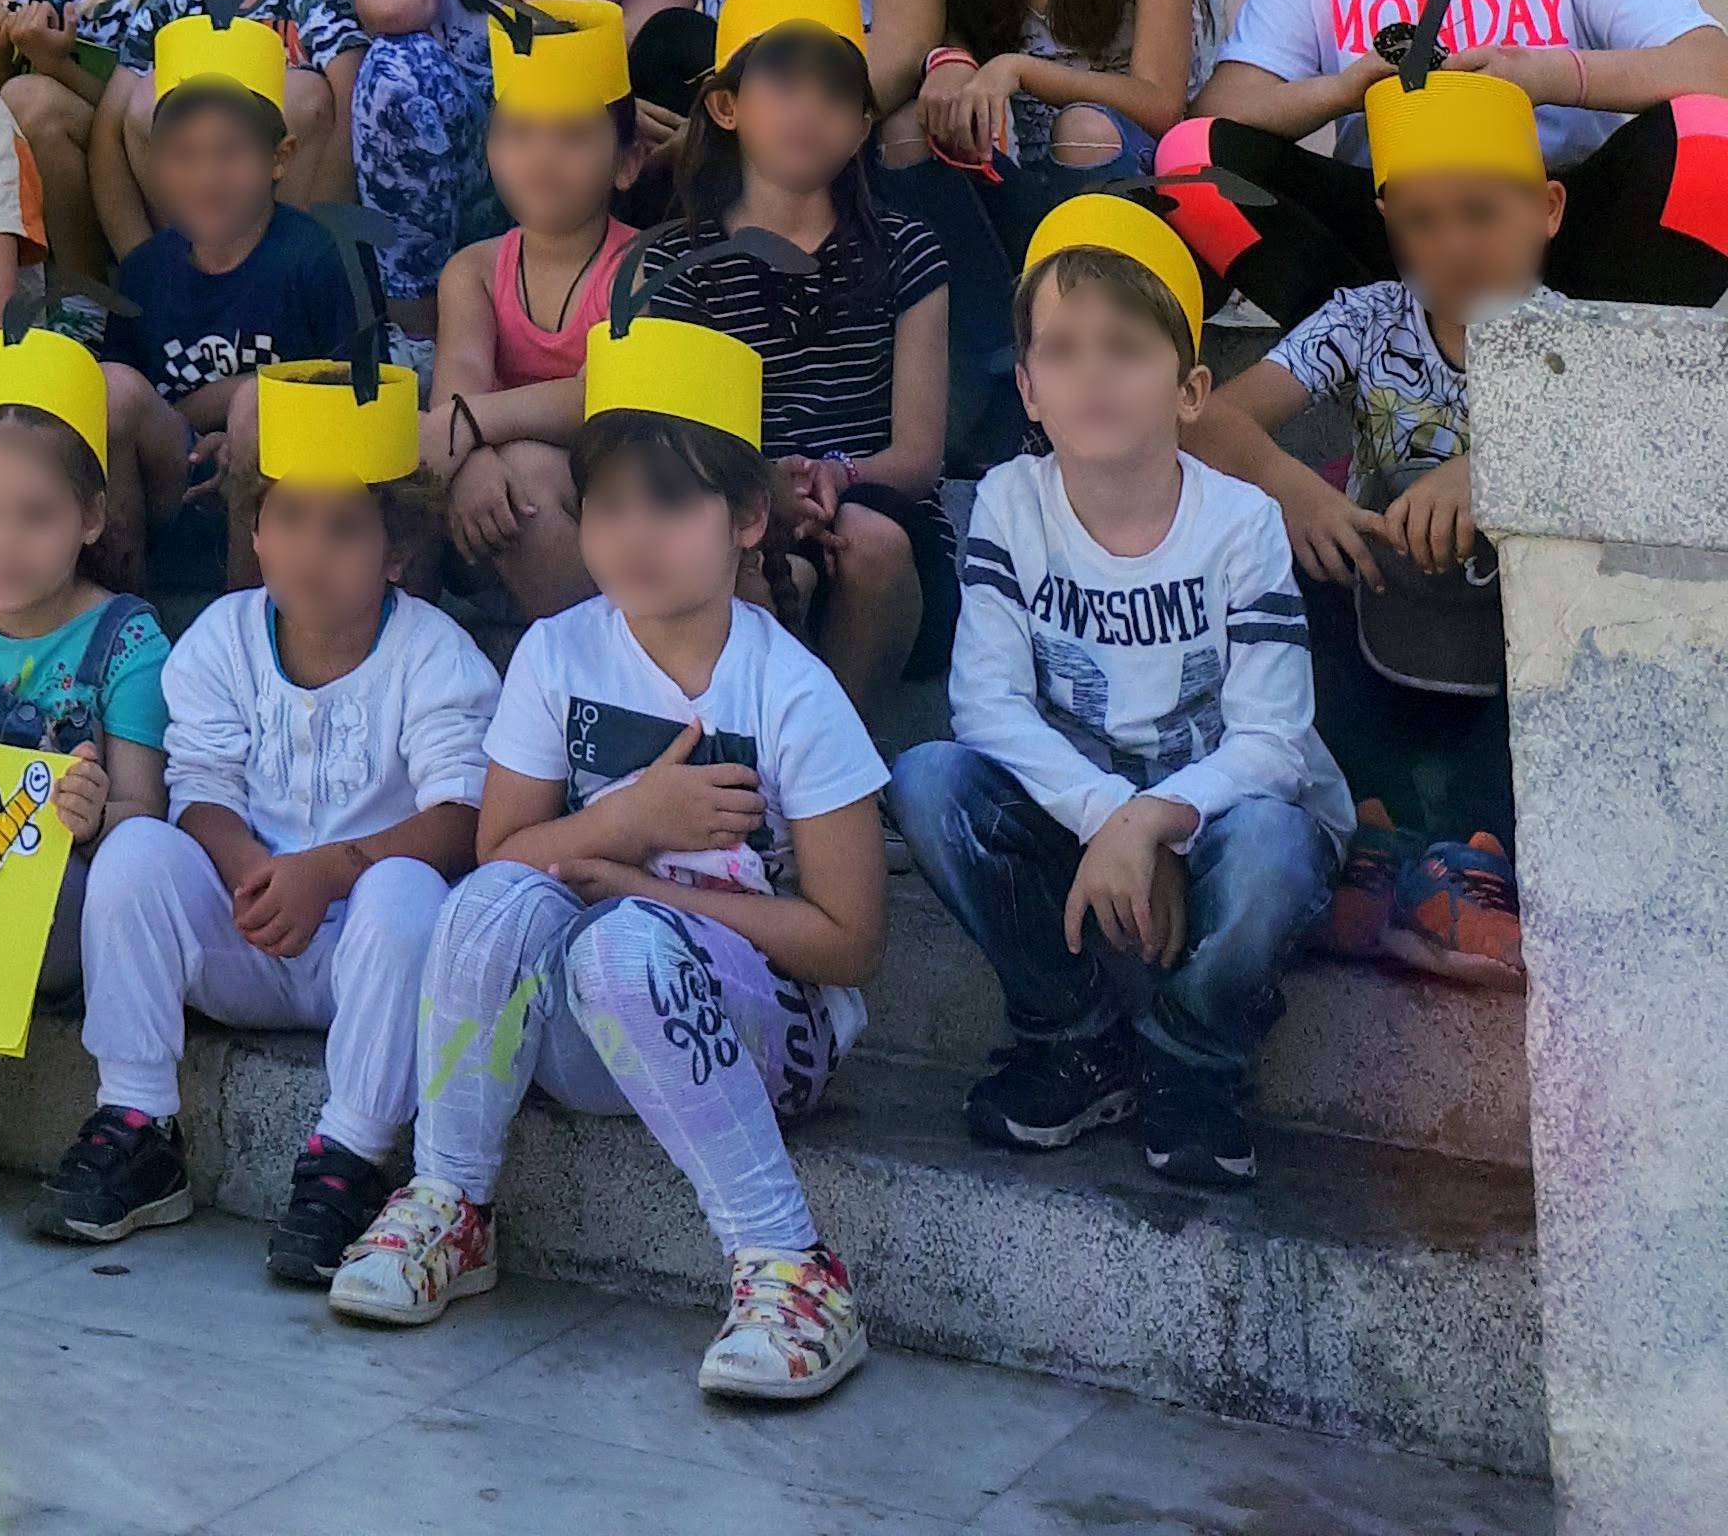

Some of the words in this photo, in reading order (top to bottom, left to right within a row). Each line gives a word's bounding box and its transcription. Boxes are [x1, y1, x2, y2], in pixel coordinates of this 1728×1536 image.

[1030, 573, 1210, 647] AWESOME
[572, 702, 599, 725] JO
[578, 721, 591, 741] Y
[569, 739, 597, 763] CE
